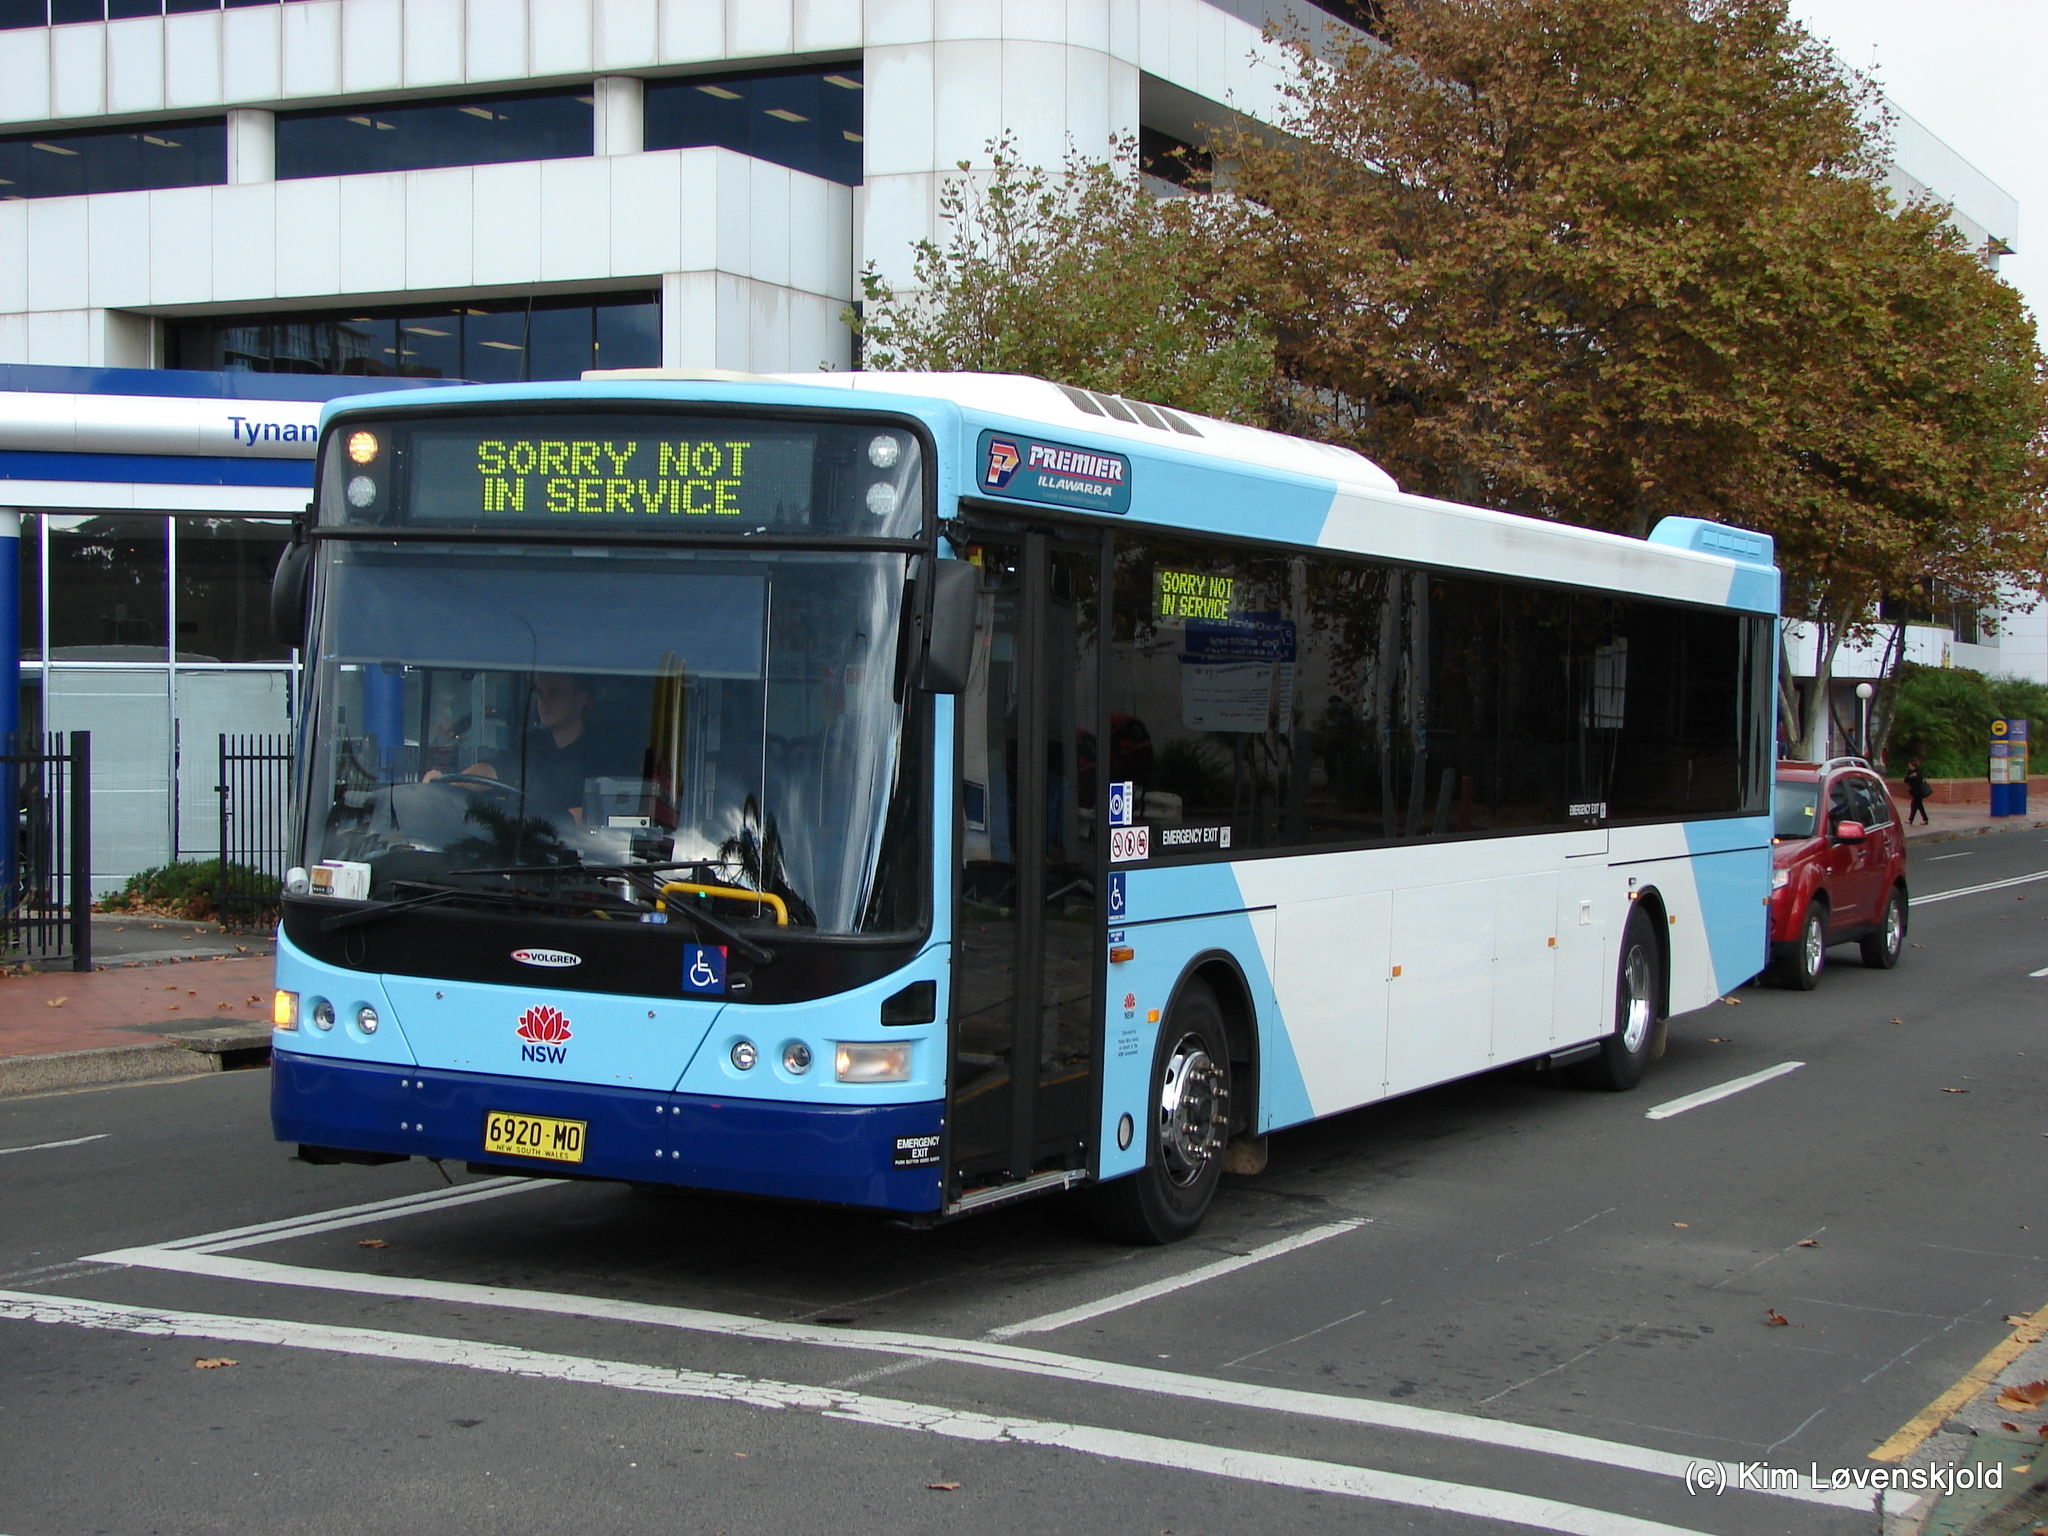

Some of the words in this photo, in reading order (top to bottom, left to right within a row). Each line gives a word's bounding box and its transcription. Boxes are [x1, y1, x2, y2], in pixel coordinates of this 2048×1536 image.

[227, 416, 318, 447] Tynan
[477, 440, 637, 475] SORRY
[658, 441, 751, 476] NOT
[1028, 445, 1123, 483] PREMIER
[484, 477, 525, 511] IN
[546, 478, 742, 514] SERVICE
[1037, 475, 1113, 497] ILLAWARRA
[1162, 572, 1205, 595] SORRY
[1209, 577, 1233, 598] NOT
[1162, 595, 1175, 615] IN
[1179, 596, 1229, 619] SERVICE
[1162, 828, 1203, 845] EMERGENCY
[1203, 826, 1219, 843] EXIT
[531, 952, 578, 965] VOLGREN
[521, 1045, 567, 1064] NSW
[496, 1144, 513, 1152] NEW
[516, 1145, 541, 1156] SOUTH
[544, 1149, 570, 1160] WALES
[897, 1136, 940, 1149] EMERGENCY
[912, 1148, 928, 1158] EXIT
